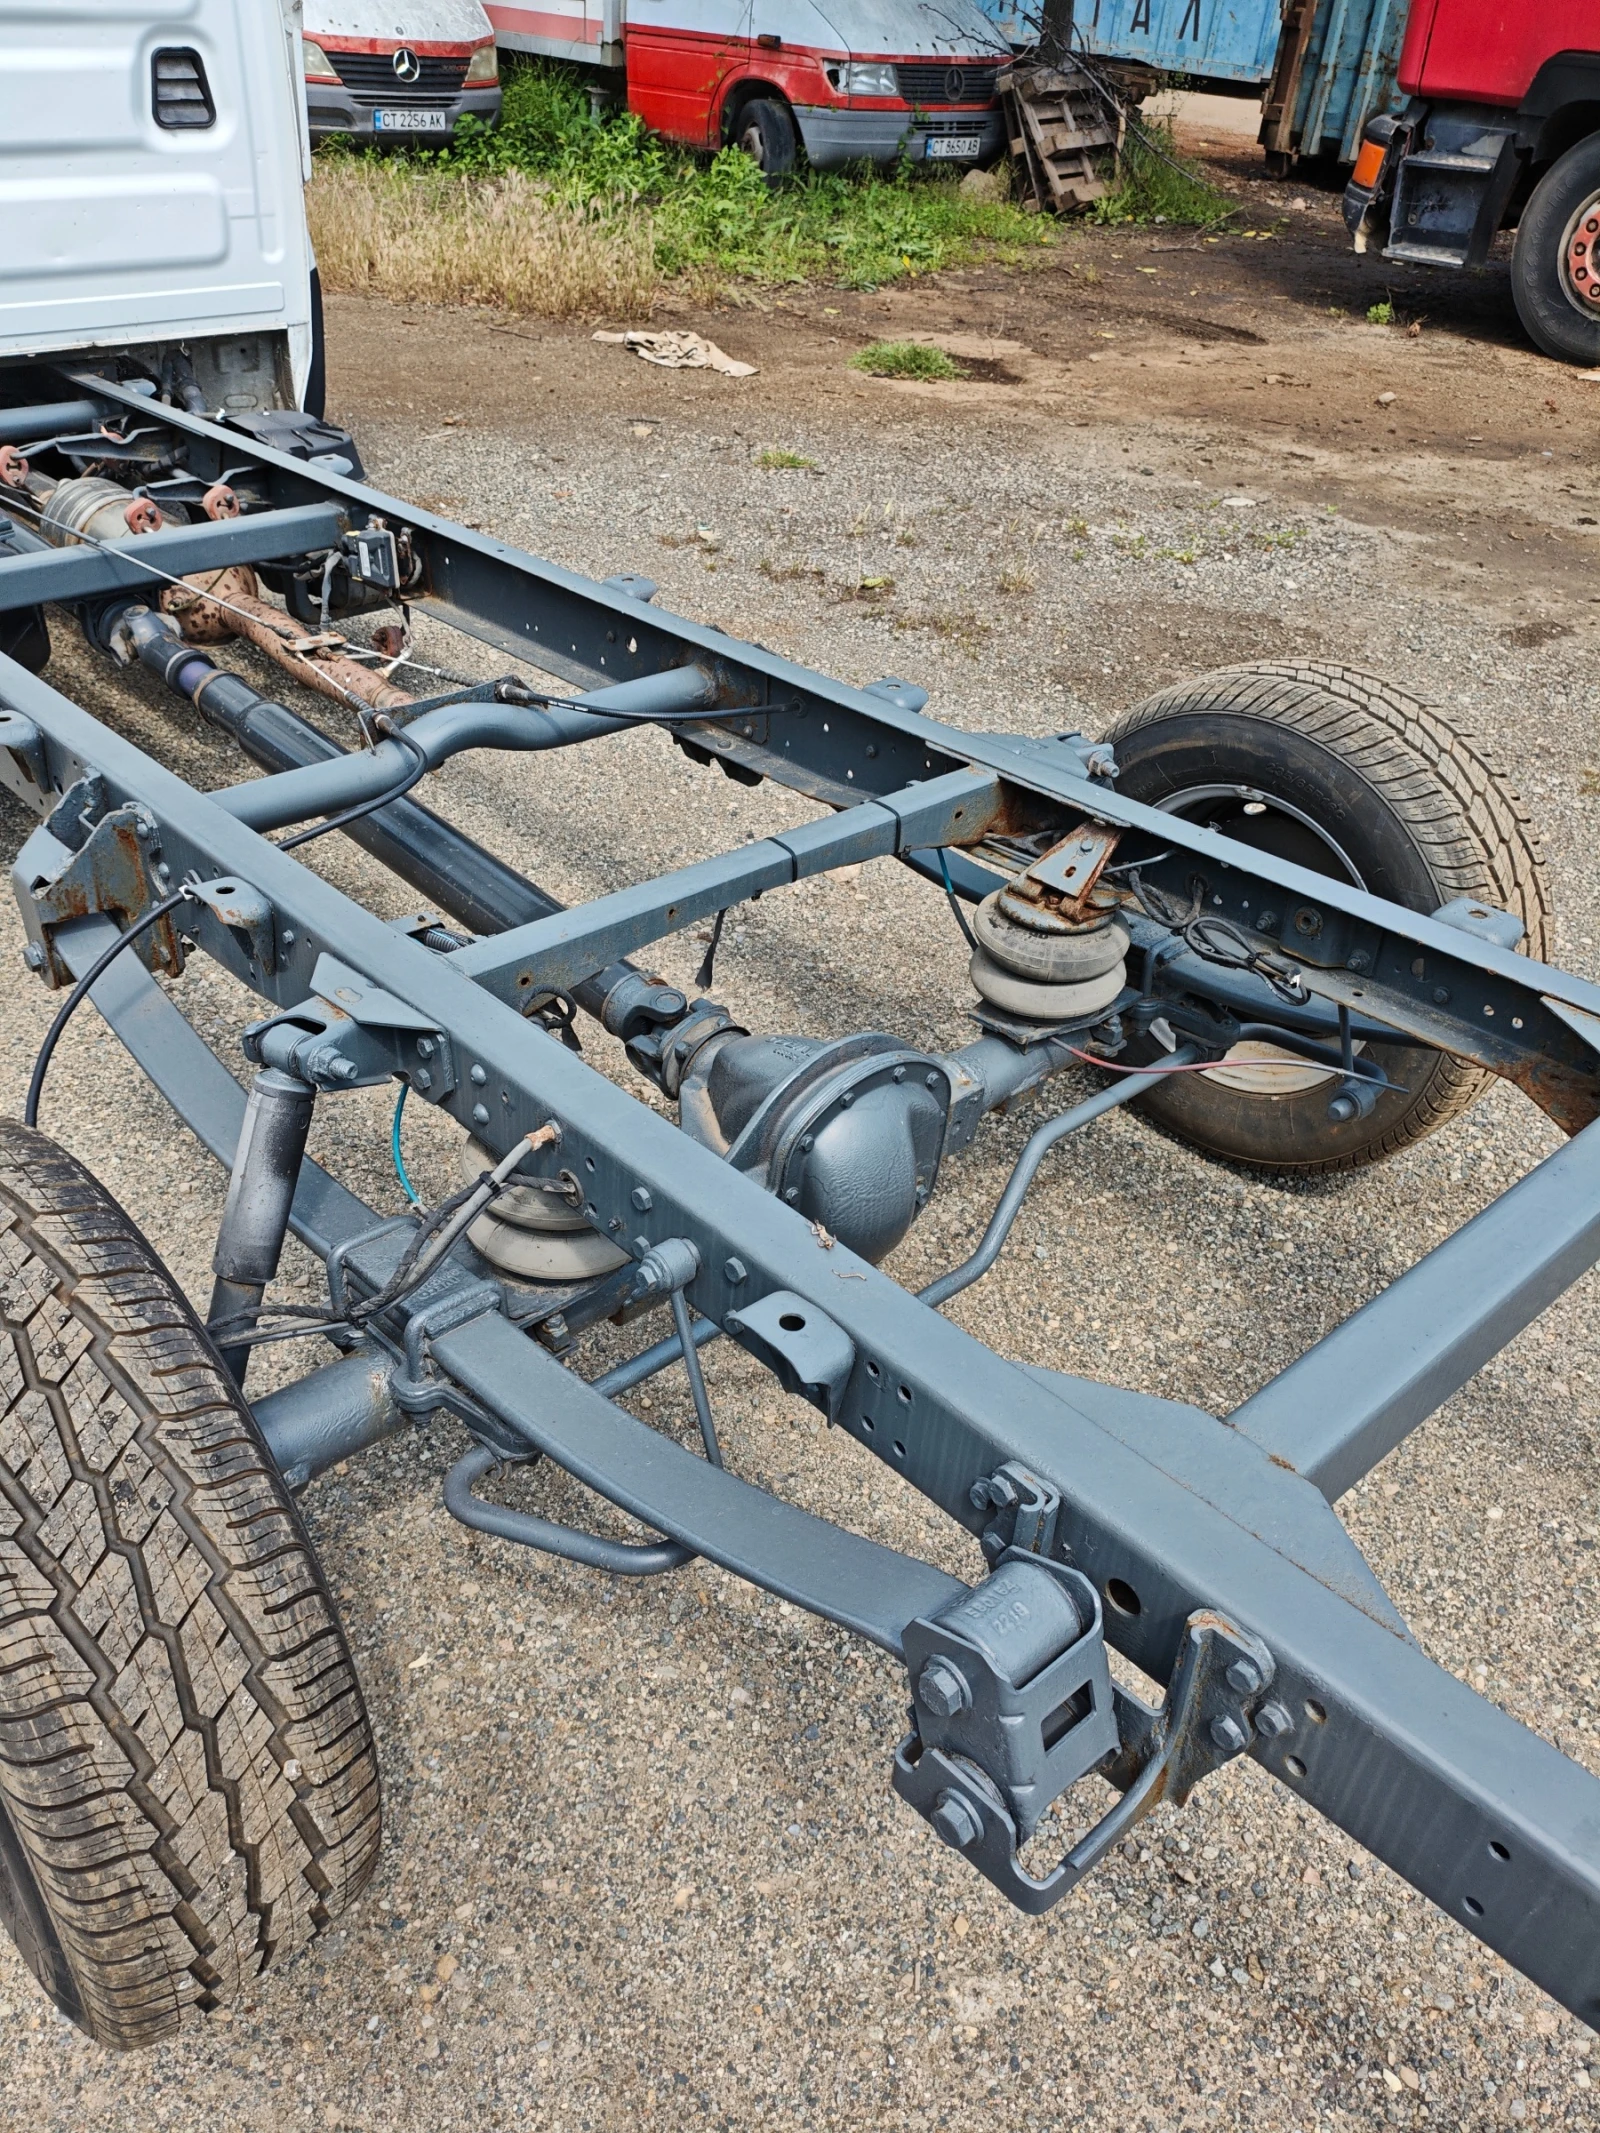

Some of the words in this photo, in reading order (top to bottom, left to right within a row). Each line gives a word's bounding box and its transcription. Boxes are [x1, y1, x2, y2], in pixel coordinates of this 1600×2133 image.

[382, 113, 397, 128] CT
[400, 113, 427, 128] 2256
[429, 114, 443, 128] AK
[932, 140, 945, 154] CT
[945, 139, 967, 154] 8650
[967, 139, 978, 154] AB
